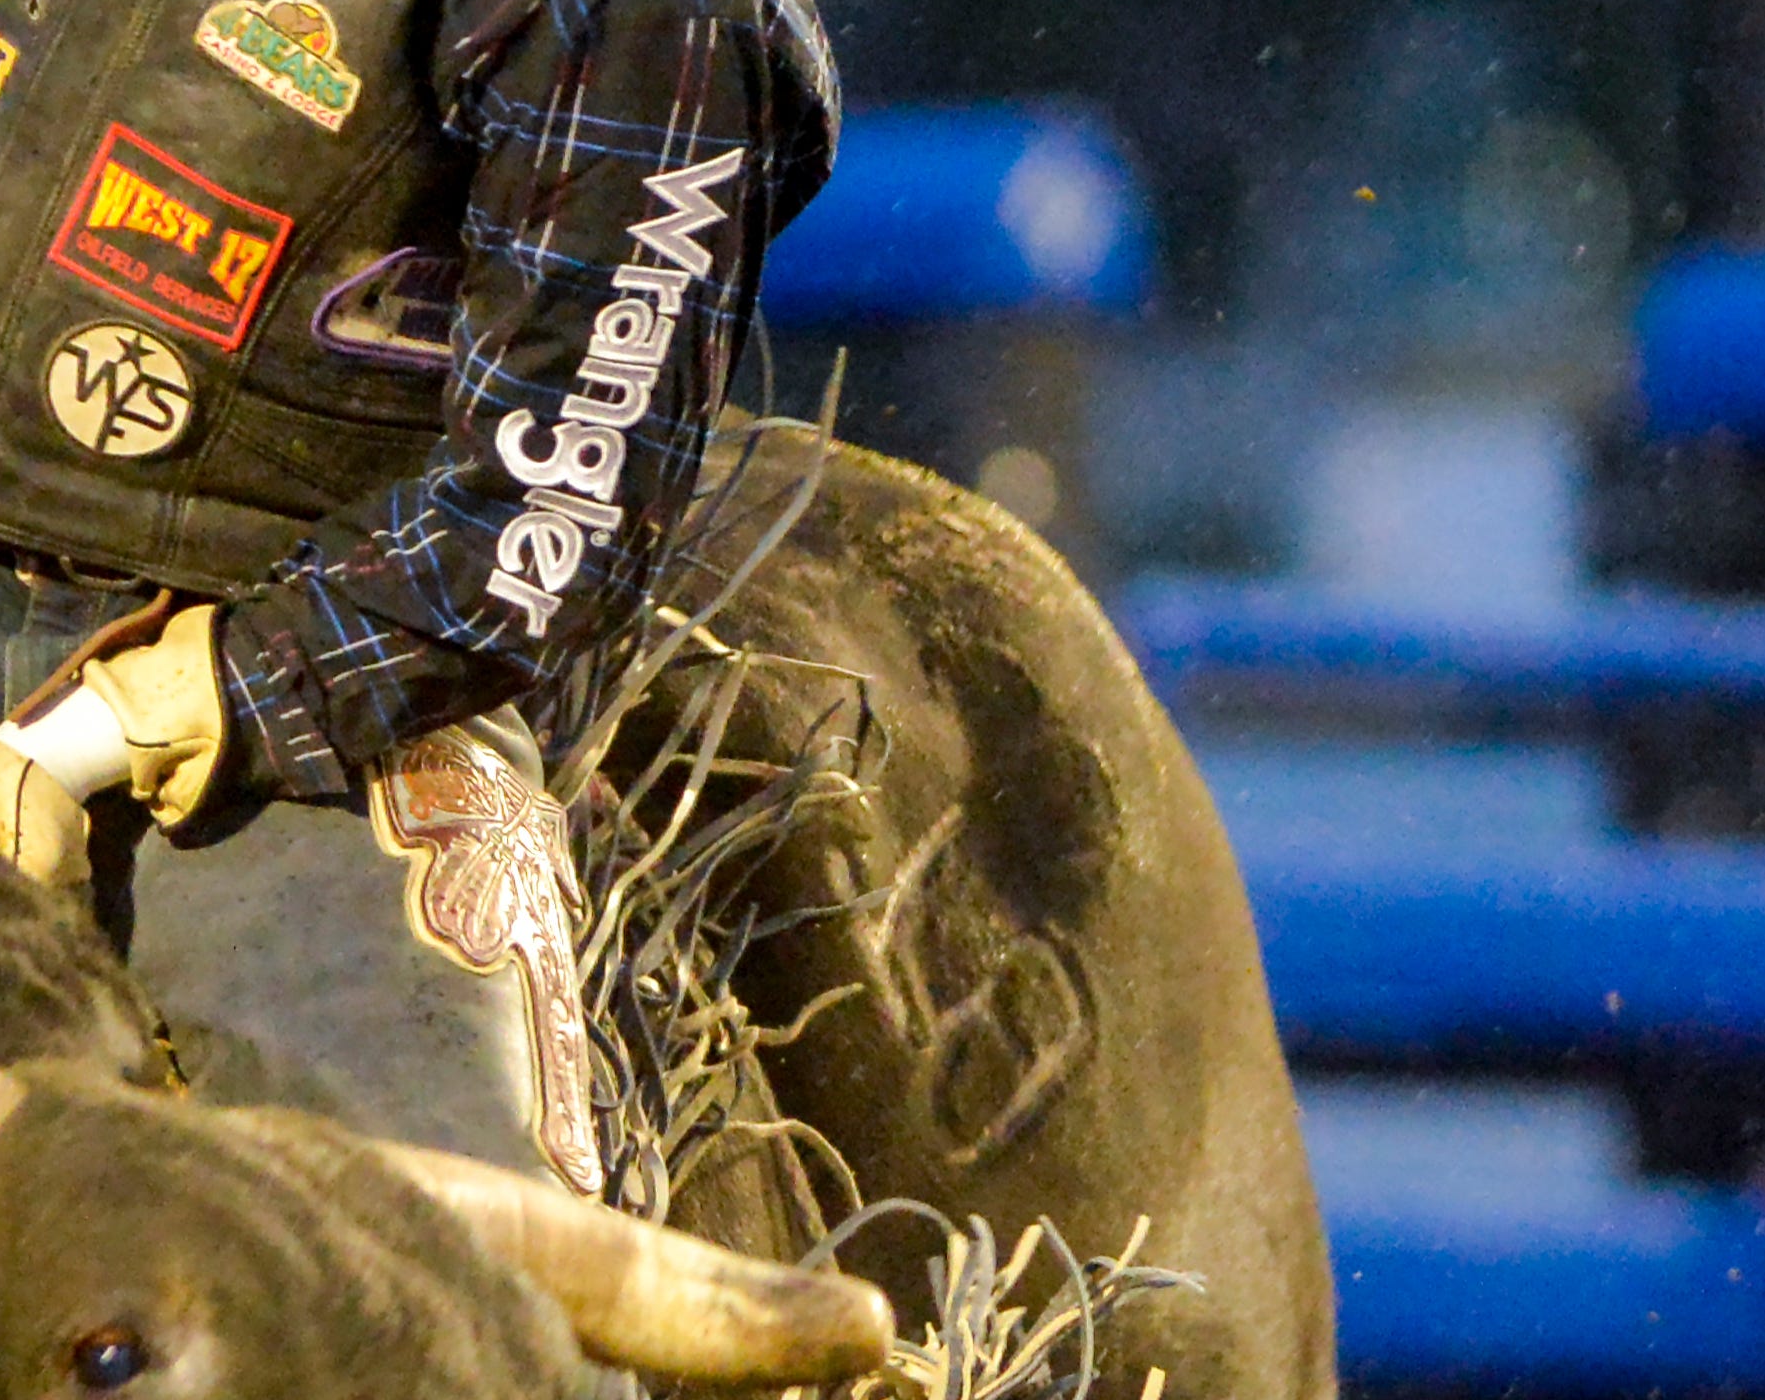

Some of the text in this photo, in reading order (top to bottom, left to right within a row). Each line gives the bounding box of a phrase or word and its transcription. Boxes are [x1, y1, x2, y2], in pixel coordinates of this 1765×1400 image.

[199, 32, 260, 77] CASINO
[283, 88, 337, 126] LODGE
[239, 16, 350, 108] BEARS
[87, 159, 213, 256] WEST
[76, 230, 149, 284] OILFIELD
[485, 146, 746, 639] Wrangler
